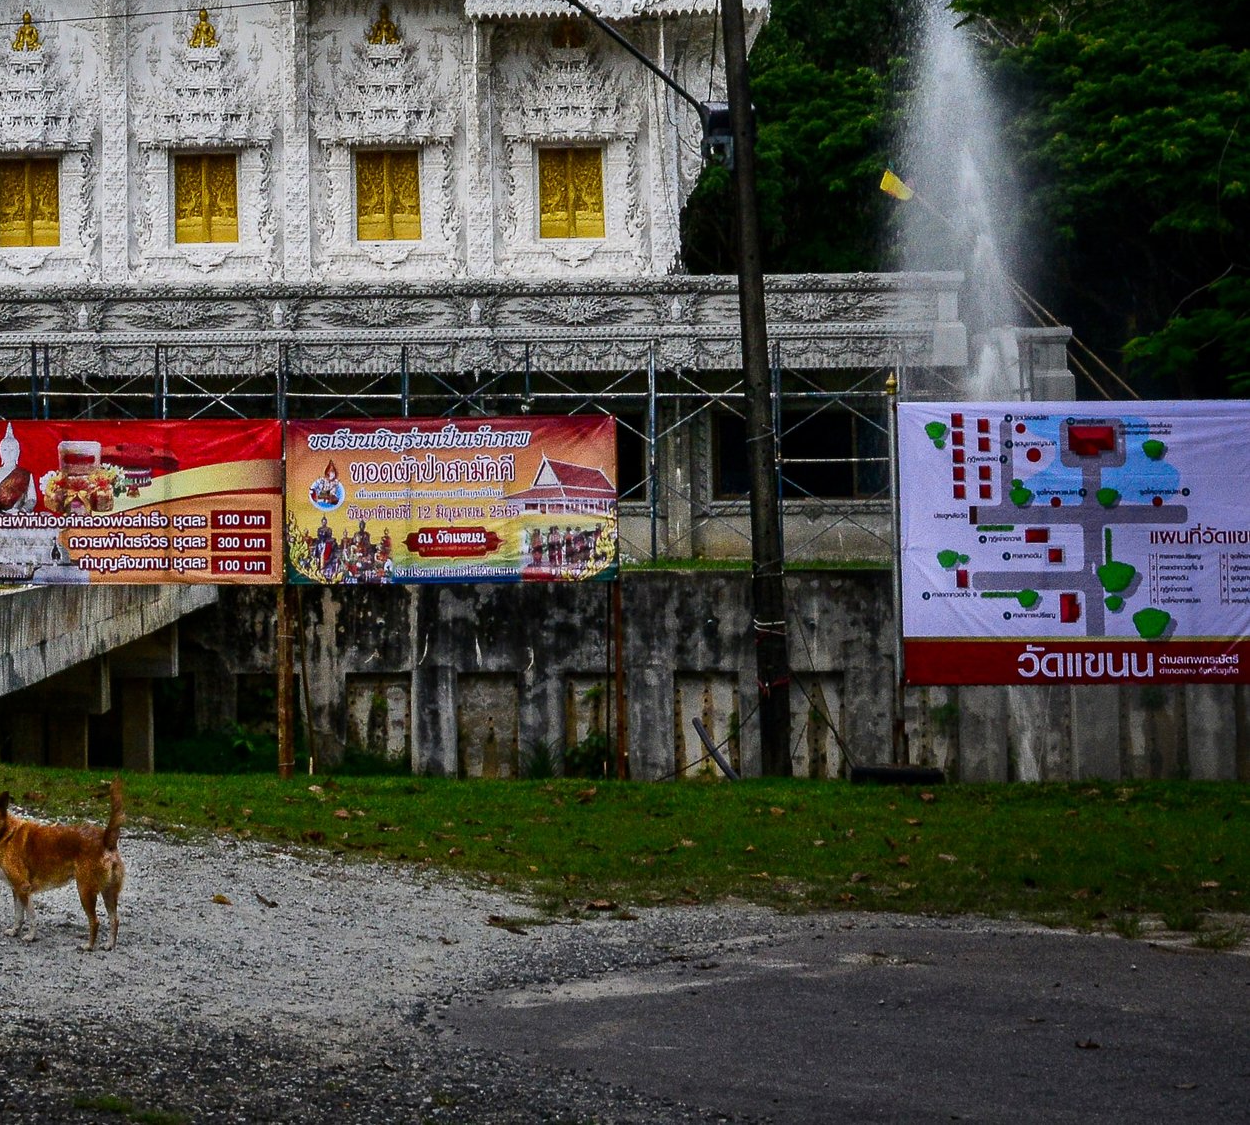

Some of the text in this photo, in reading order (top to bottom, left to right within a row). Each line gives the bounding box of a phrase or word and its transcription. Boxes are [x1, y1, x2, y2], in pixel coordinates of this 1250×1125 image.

[308, 426, 531, 451] ขอเรียนเชิญร่วมเป็นเจ้าภาพ
[350, 454, 516, 483] ทอดผ้าป่าสามัคคี
[347, 502, 521, 522] วันอาทิตย์ที่ 12 มิถุนายน 2565
[172, 515, 207, 531] ชุดละ
[217, 513, 240, 526] 100
[243, 514, 266, 526] บาท
[69, 533, 266, 552] ถวายผ้าไตรจีวร ชุดละ 300 บาท
[417, 529, 487, 544] ณ วัดแขนน
[1150, 523, 1250, 544] แผนที่วัดแข
[78, 555, 266, 573] ทำบุญสังฆทาน ชุดละ 100 บาท
[1017, 644, 1154, 677] วัดแขนน
[1158, 653, 1240, 665] ตำบลเทพกระษัตรี
